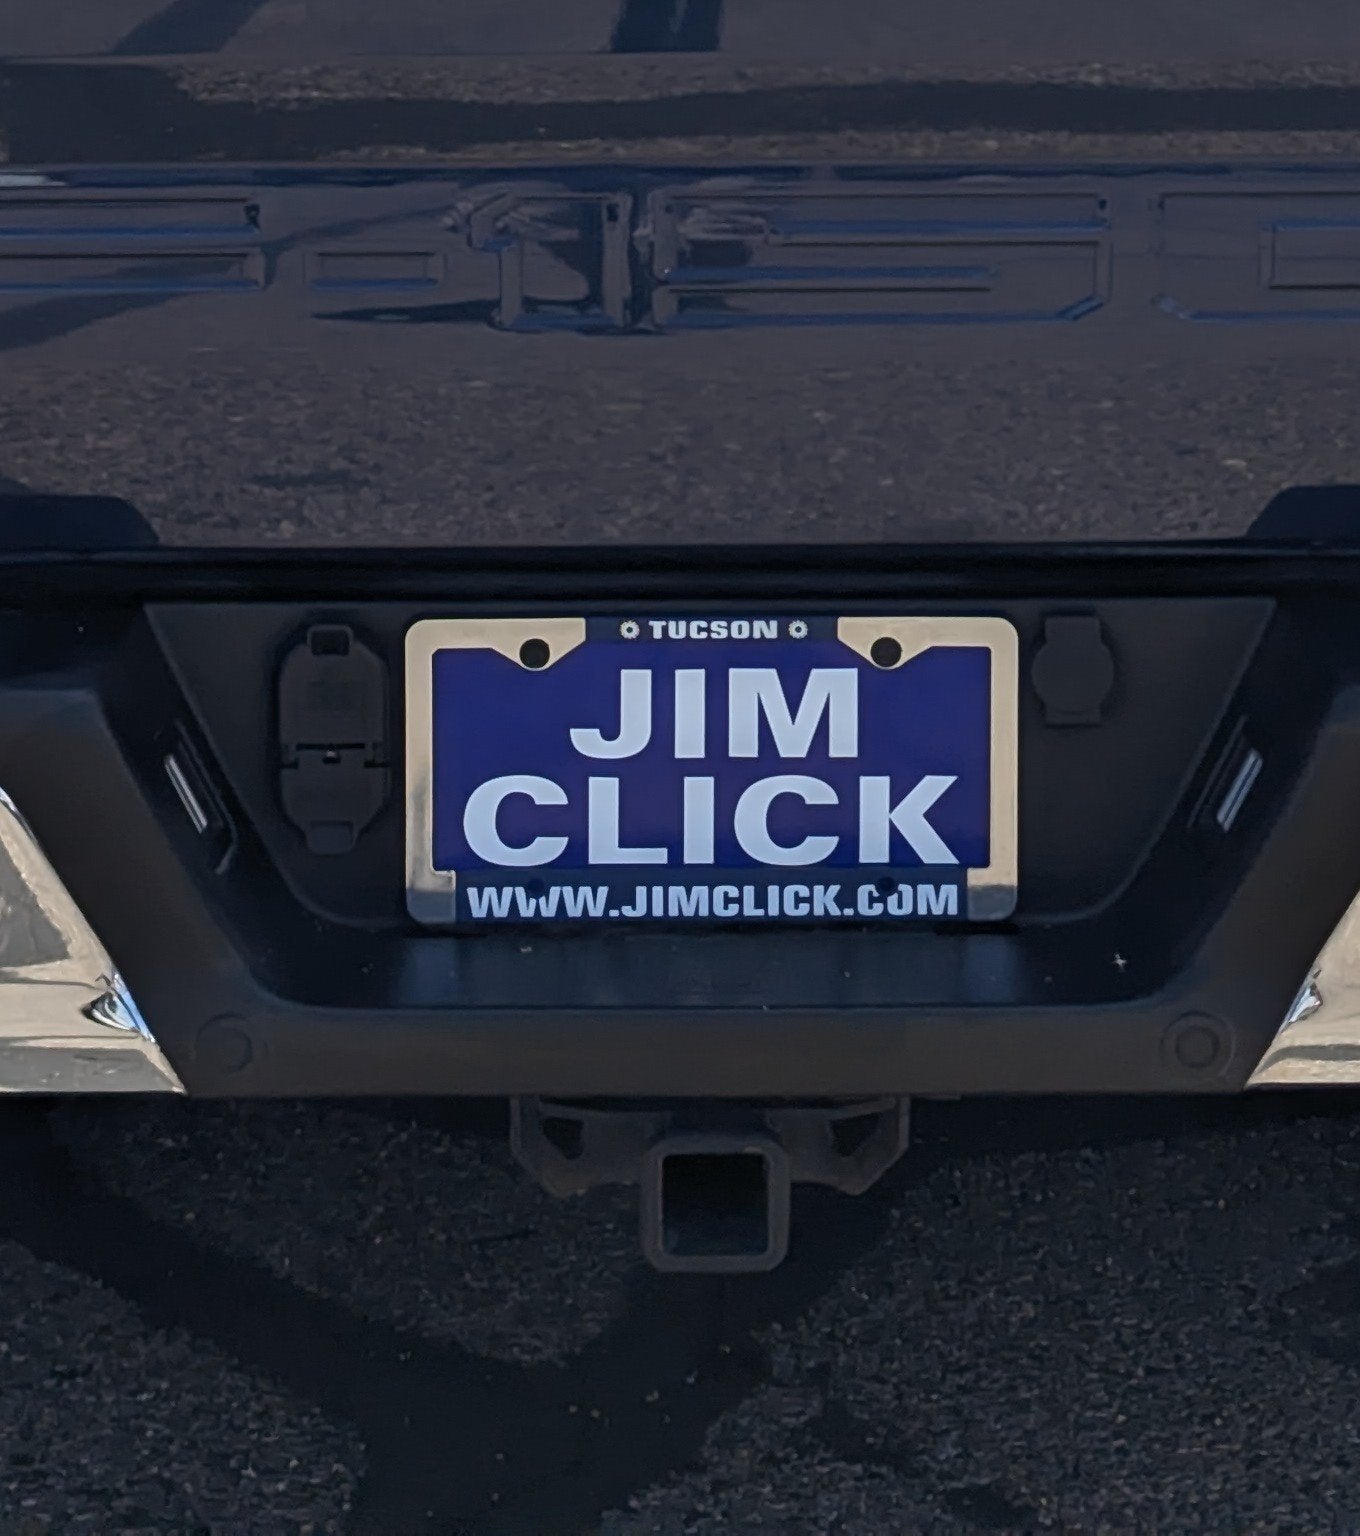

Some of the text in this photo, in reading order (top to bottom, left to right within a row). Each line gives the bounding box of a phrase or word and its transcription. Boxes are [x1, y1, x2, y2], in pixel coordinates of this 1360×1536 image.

[649, 620, 779, 640] TUCSON
[569, 667, 859, 760] JIM
[462, 774, 960, 866] CLICK
[466, 883, 959, 919] WWW.JIMCLICK.COM
